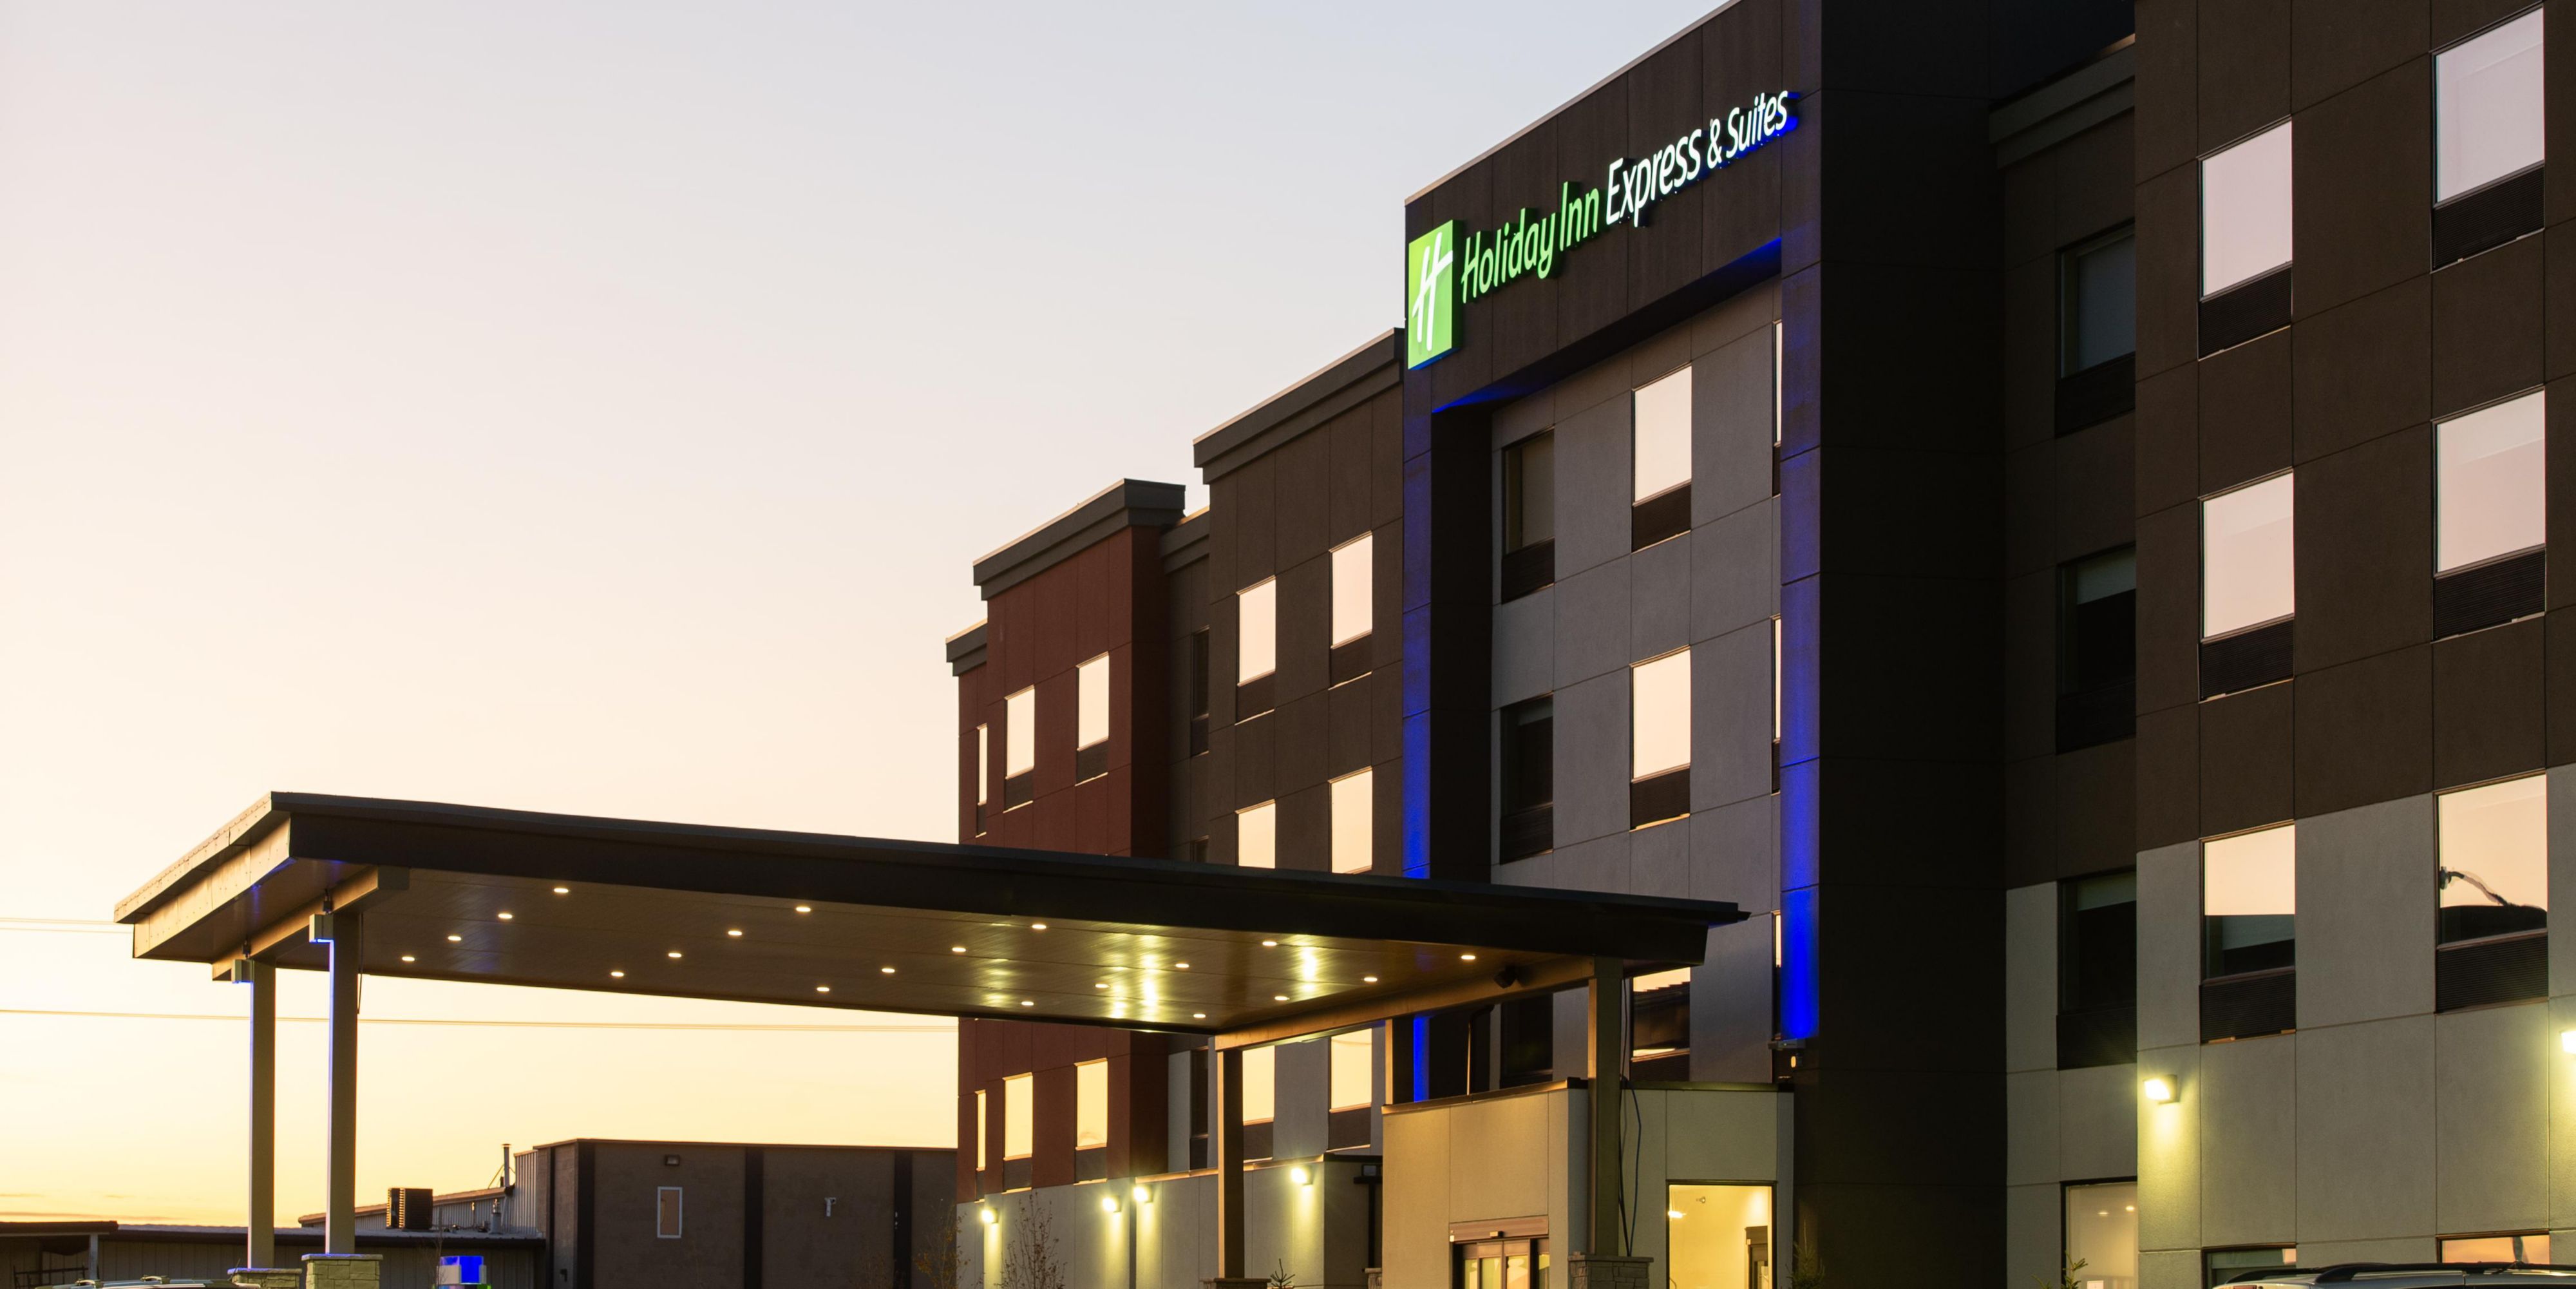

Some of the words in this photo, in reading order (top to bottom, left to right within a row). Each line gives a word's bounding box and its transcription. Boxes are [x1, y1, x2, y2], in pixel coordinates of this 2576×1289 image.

[1461, 207, 1556, 303] Holiday
[1559, 181, 1600, 251] Inn
[1606, 129, 1701, 227] Express
[1707, 119, 1722, 169] &
[1725, 90, 1788, 158] Suites
